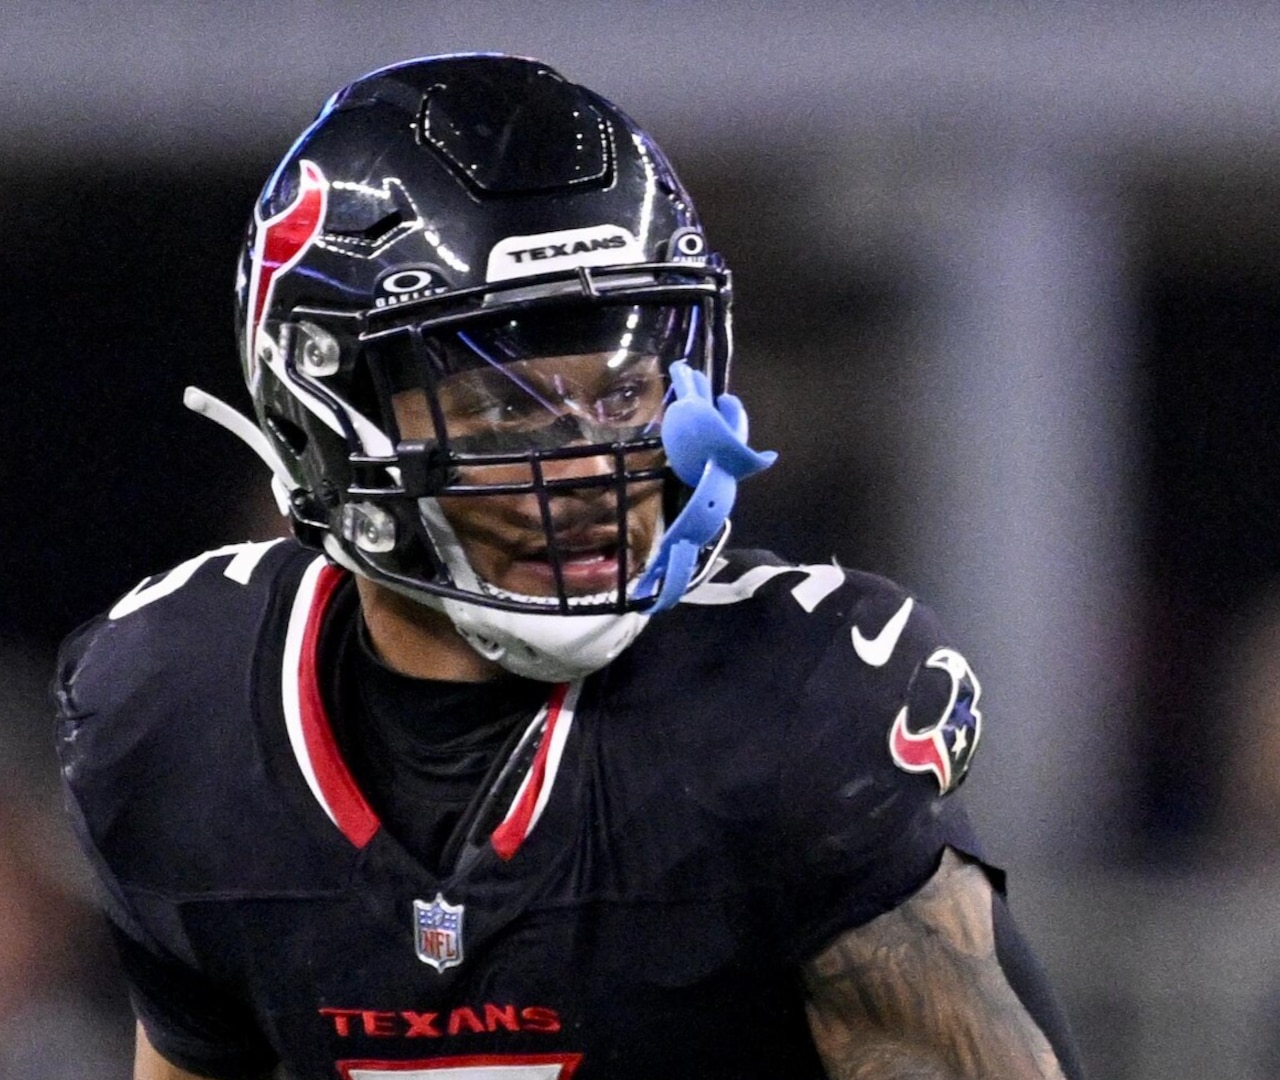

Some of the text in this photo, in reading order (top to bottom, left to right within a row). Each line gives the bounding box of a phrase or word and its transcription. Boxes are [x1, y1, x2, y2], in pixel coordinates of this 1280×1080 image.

[507, 235, 627, 263] TEXANS
[422, 930, 456, 958] NFL
[318, 1002, 563, 1039] TEXANS
